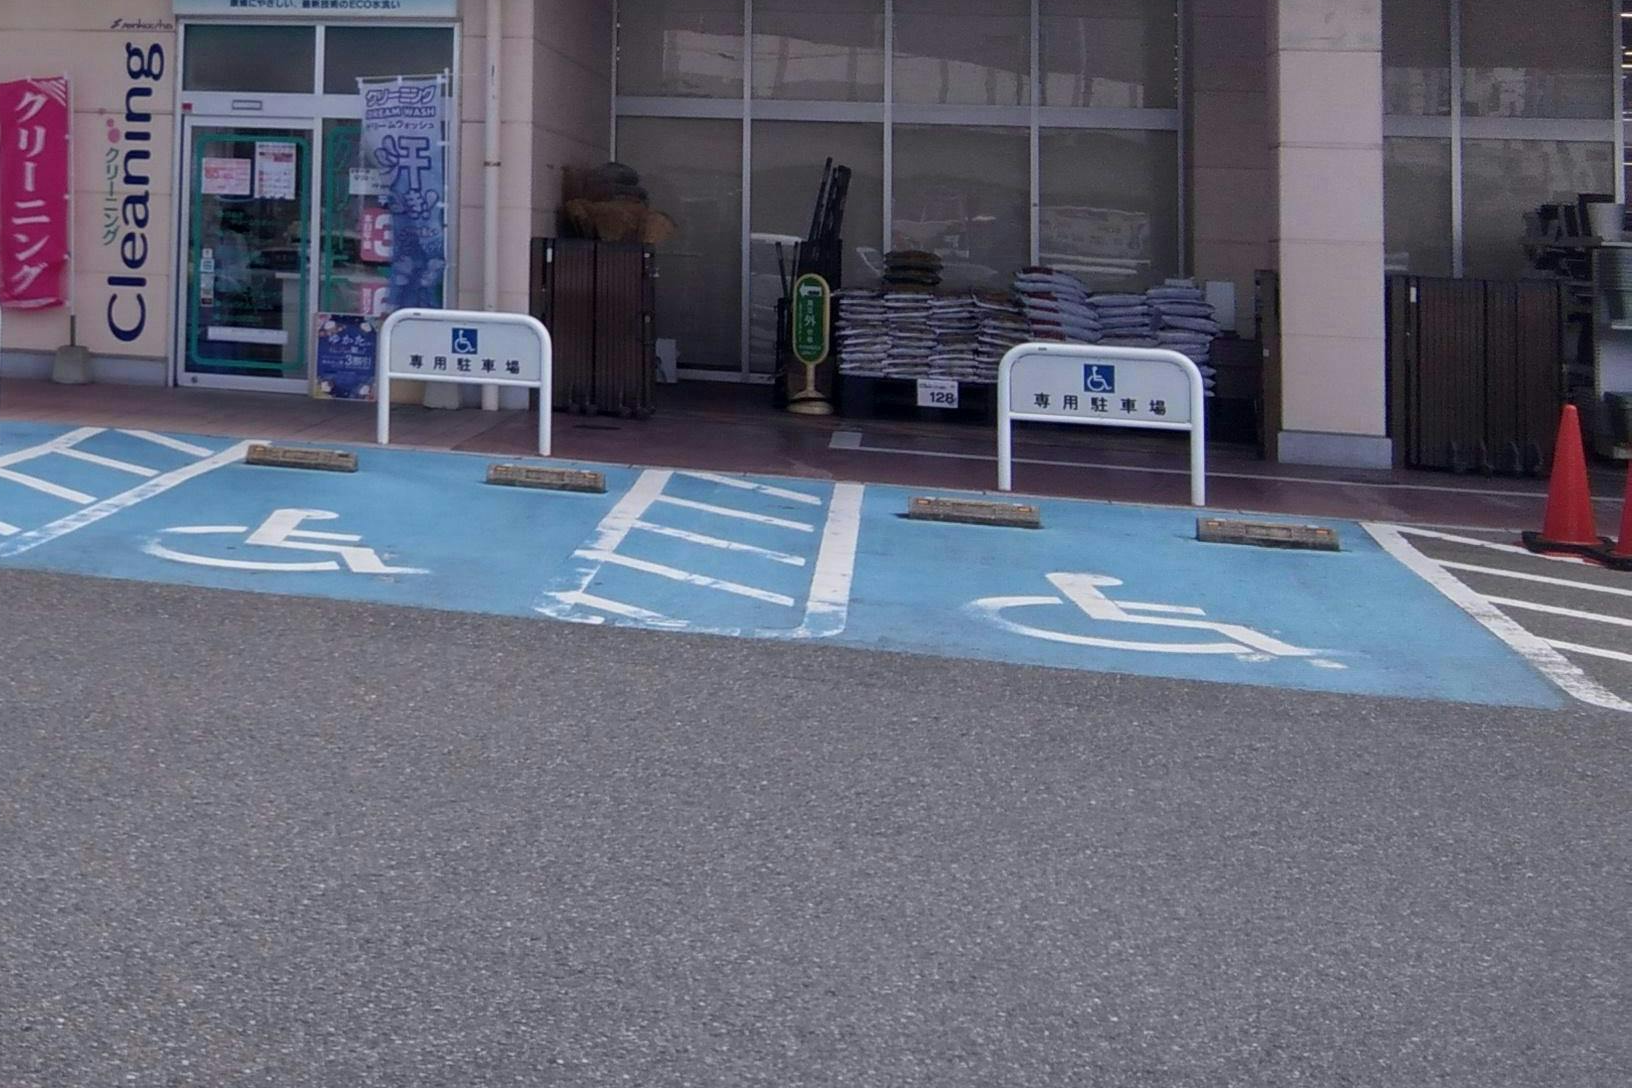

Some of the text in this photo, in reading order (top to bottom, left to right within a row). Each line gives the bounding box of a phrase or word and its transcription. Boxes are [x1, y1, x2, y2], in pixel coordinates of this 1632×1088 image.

[365, 86, 437, 108] クリーニング
[403, 106, 436, 118] WASH
[11, 90, 53, 294] クリーニング
[102, 147, 121, 247] クリーニング
[107, 41, 165, 343] Cleaning
[408, 355, 522, 376] 専用駐車場
[929, 391, 955, 404] 128
[1033, 391, 1168, 417] 専用駐車場
